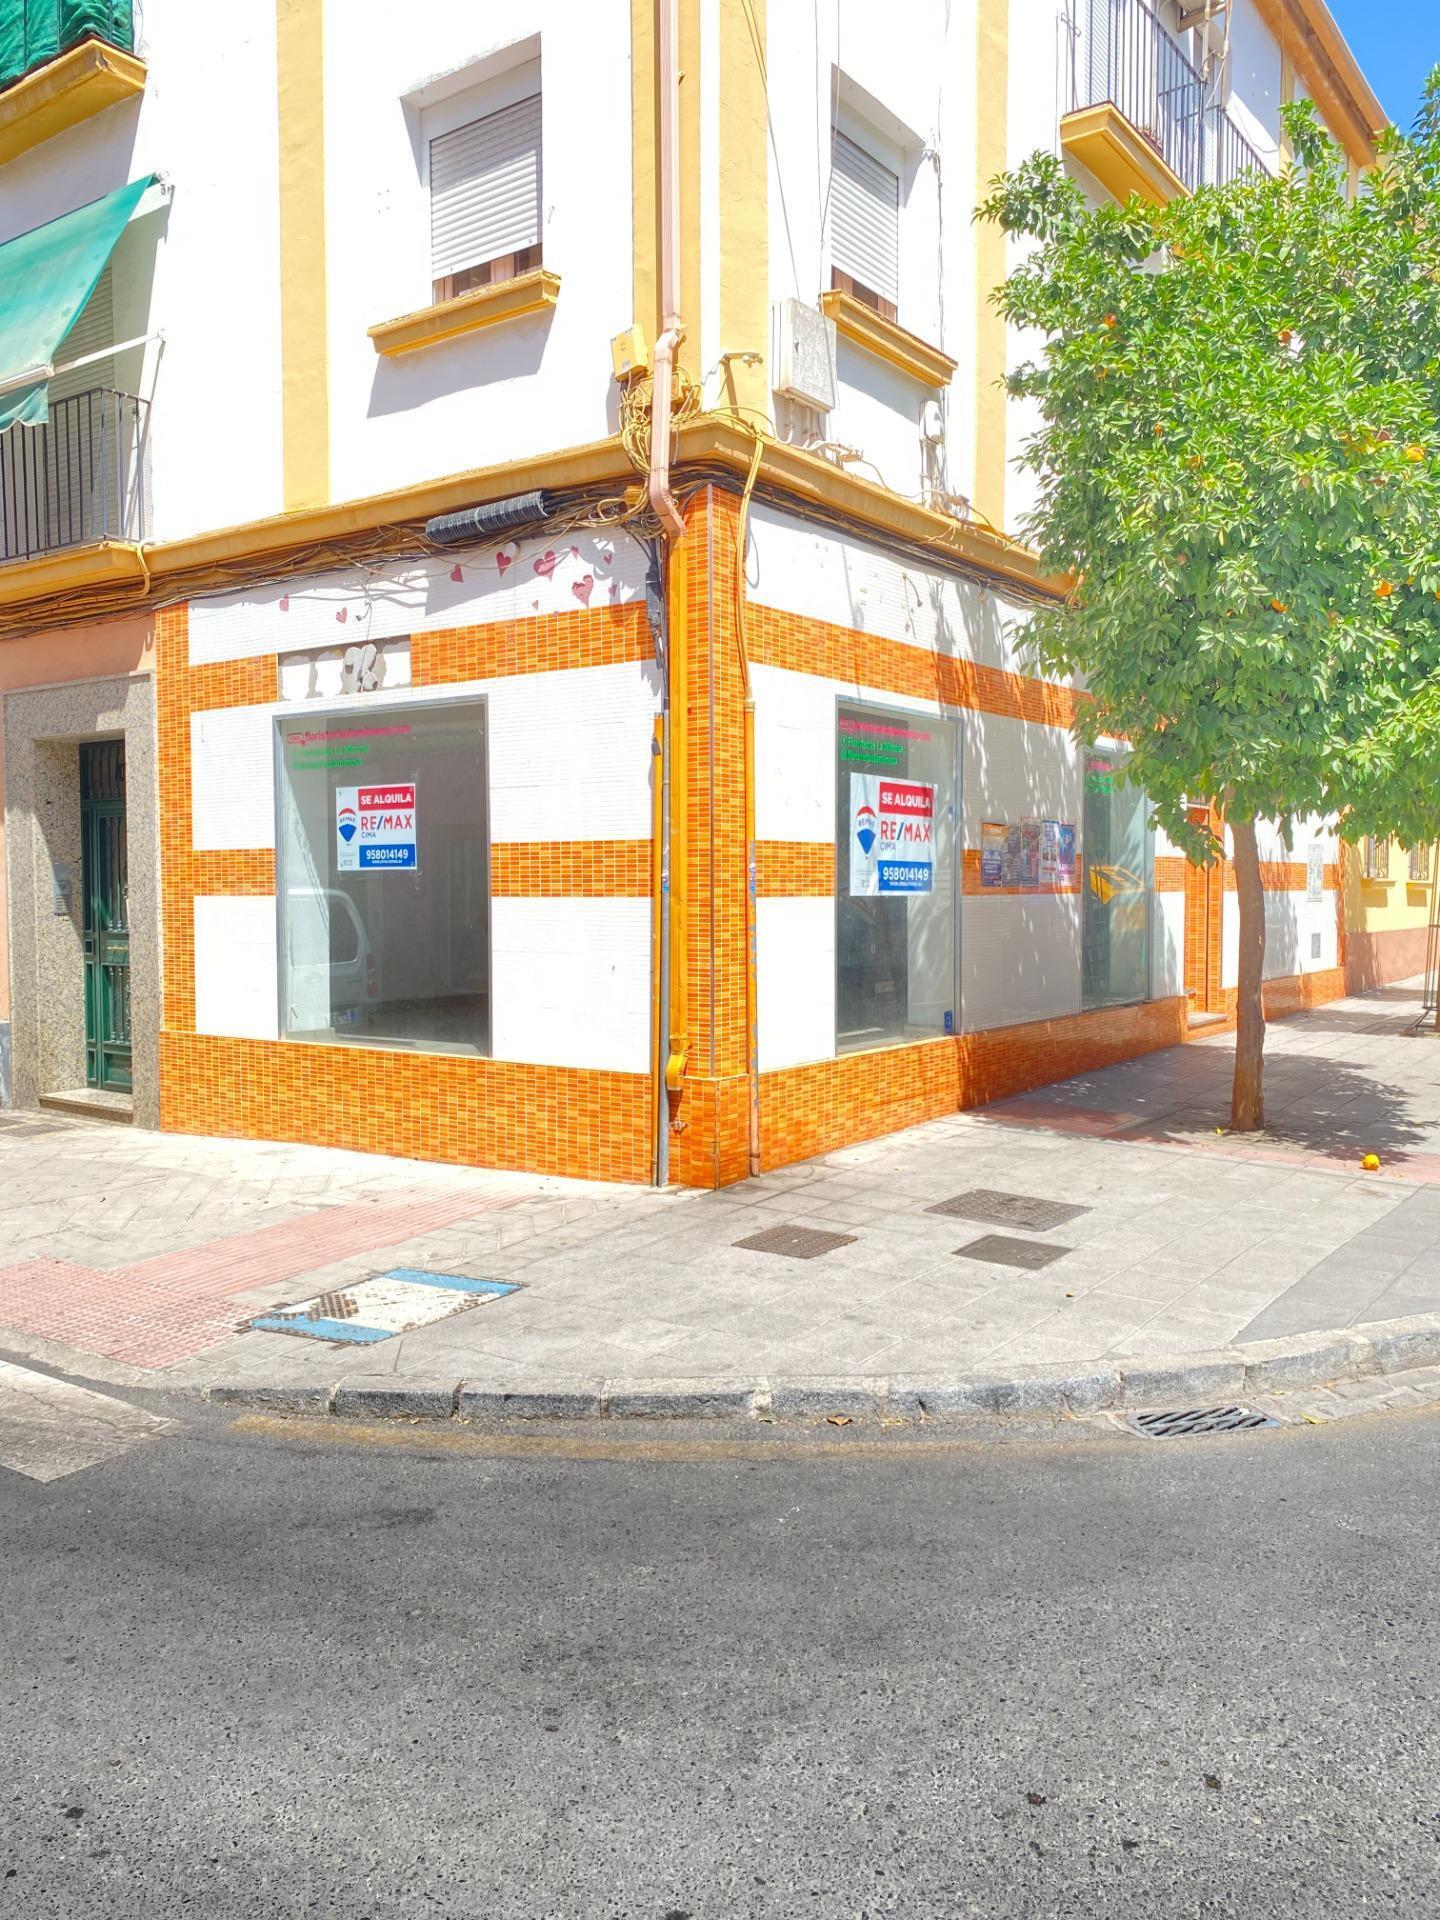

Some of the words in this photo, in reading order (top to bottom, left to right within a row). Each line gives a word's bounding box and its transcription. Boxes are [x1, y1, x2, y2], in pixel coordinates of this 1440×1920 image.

[361, 795, 372, 805] SE
[373, 793, 412, 805] ALQUILA
[882, 792, 893, 805] SE
[894, 793, 931, 809] ALQUILA
[361, 814, 413, 831] RE/MAX
[361, 831, 377, 839] CIMA
[880, 820, 932, 843] RE/MAX
[880, 841, 897, 851] CIMA
[366, 848, 409, 860] 958014149
[883, 866, 929, 881] 958014149
